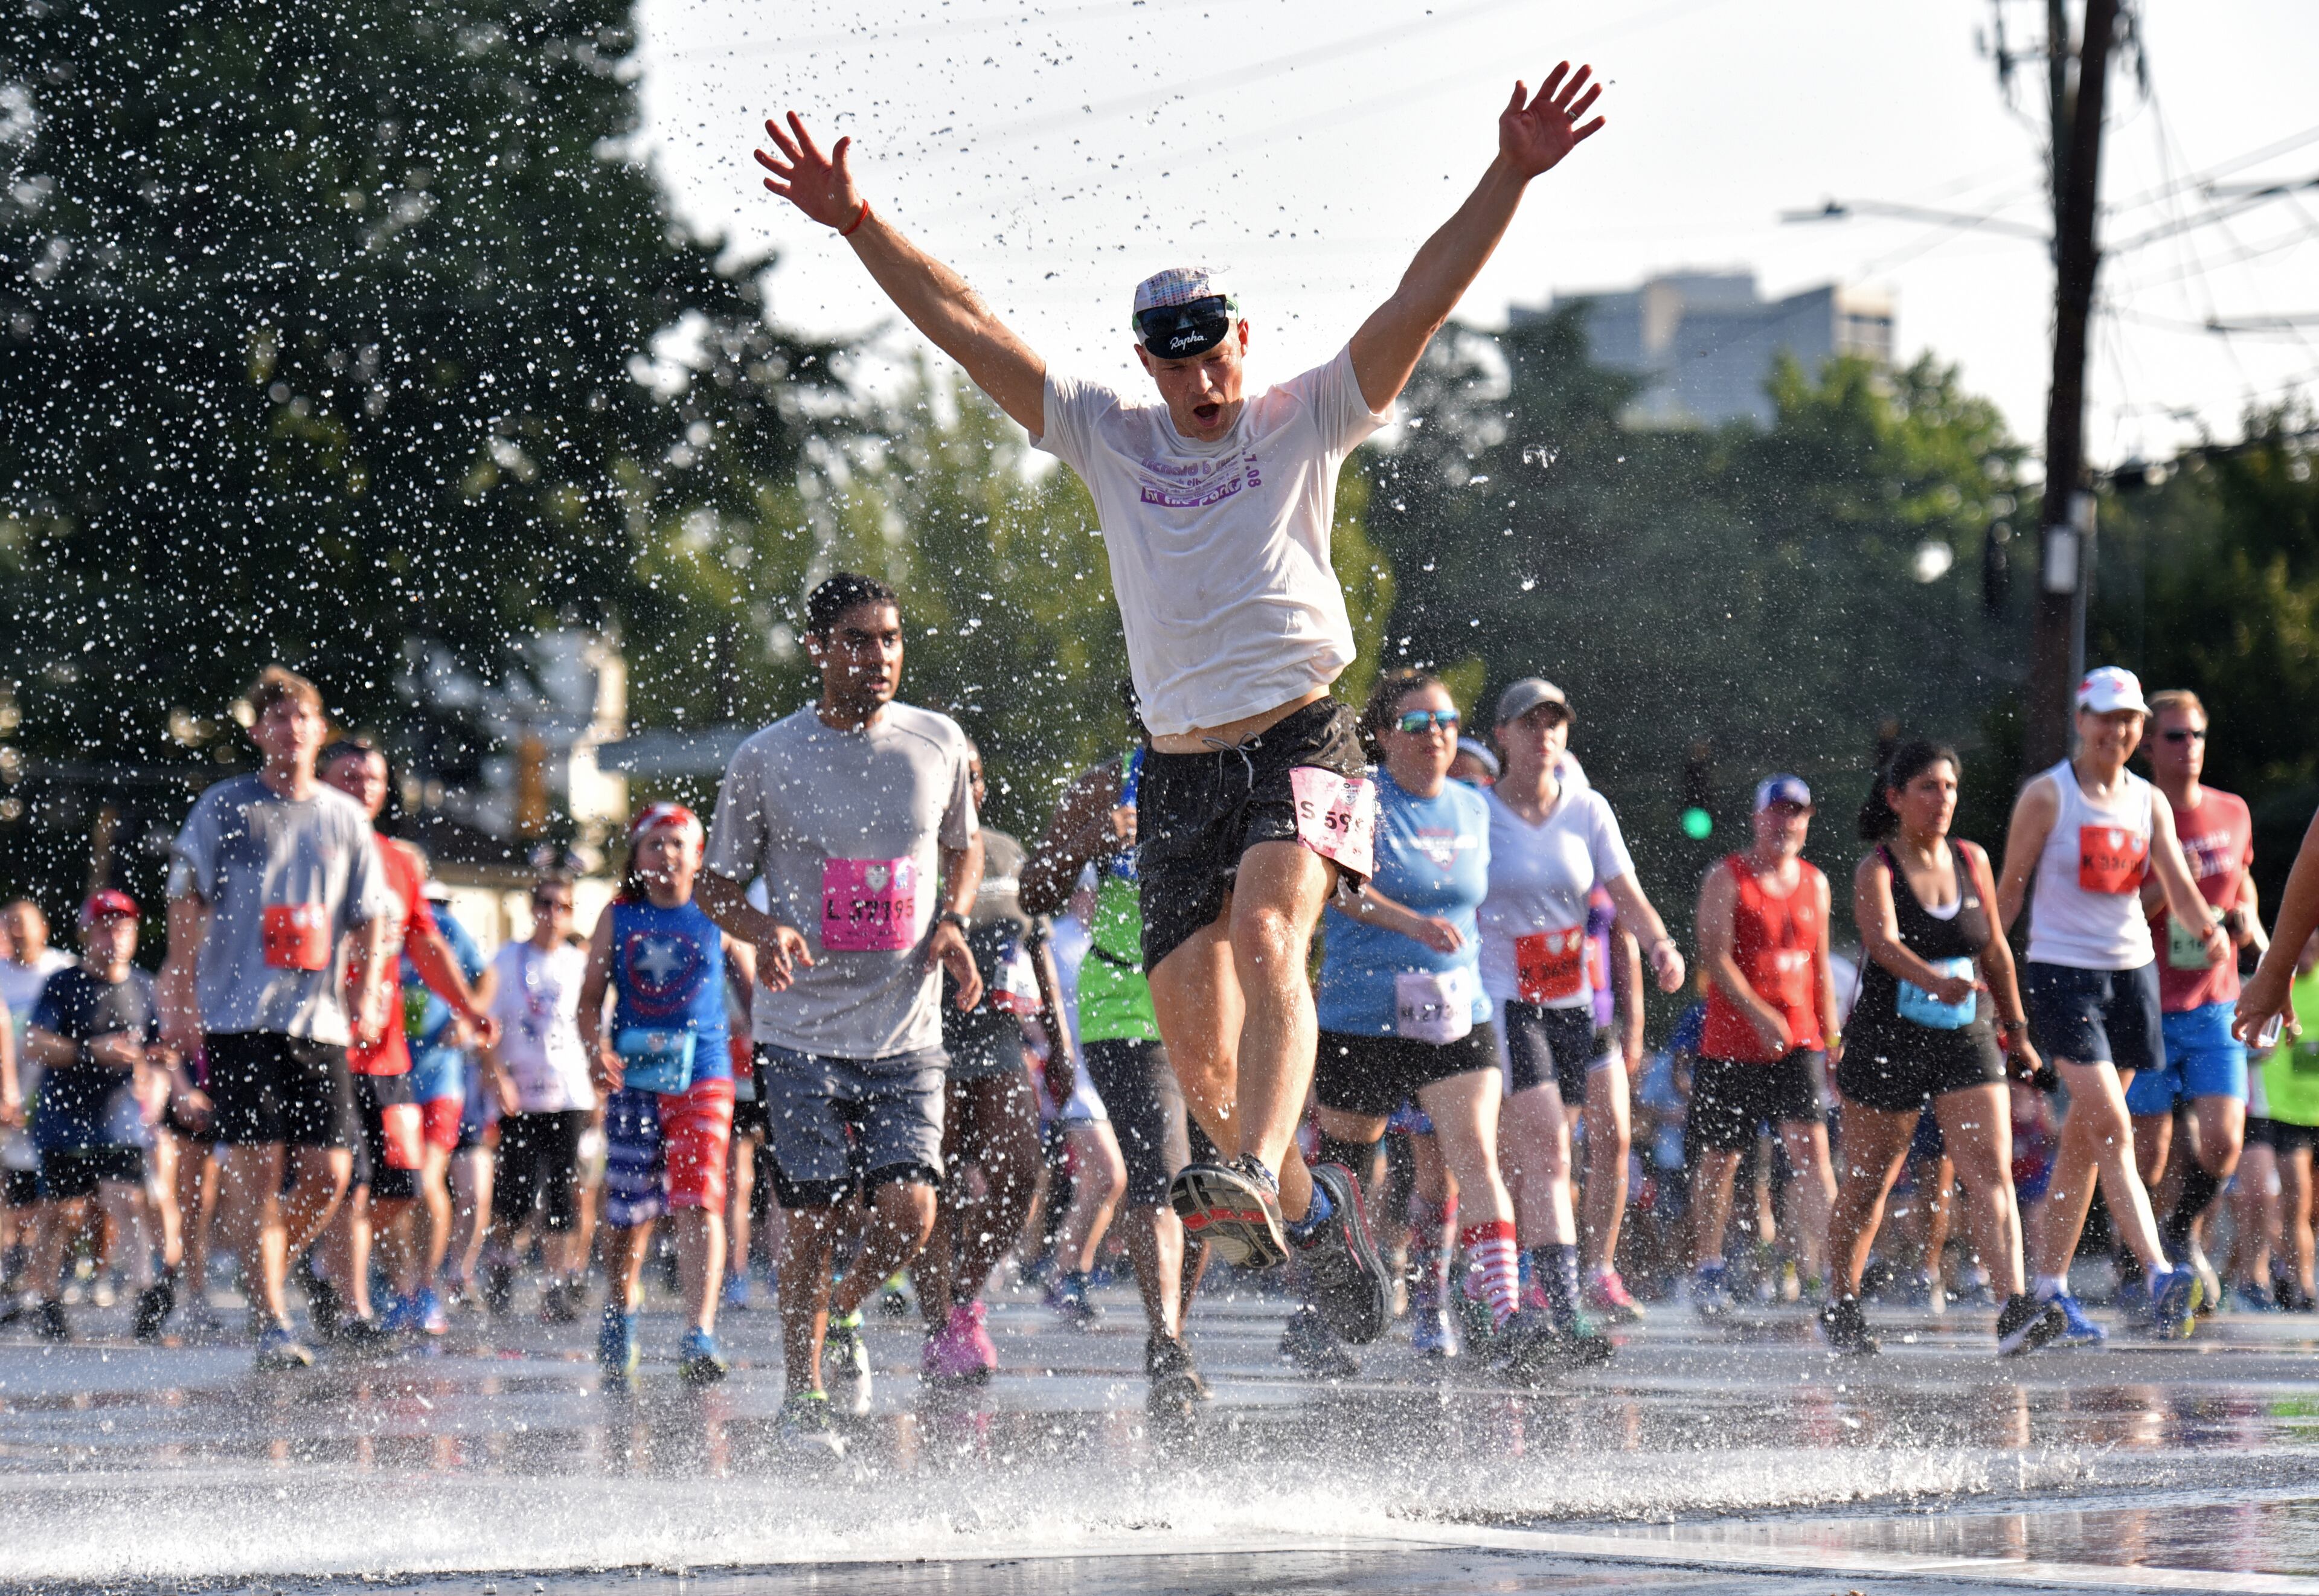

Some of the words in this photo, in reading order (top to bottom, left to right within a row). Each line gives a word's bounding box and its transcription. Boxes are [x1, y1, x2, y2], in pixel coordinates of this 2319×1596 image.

[1170, 330, 1208, 350] Rapha.
[1300, 800, 1315, 820] S
[827, 899, 841, 920] L
